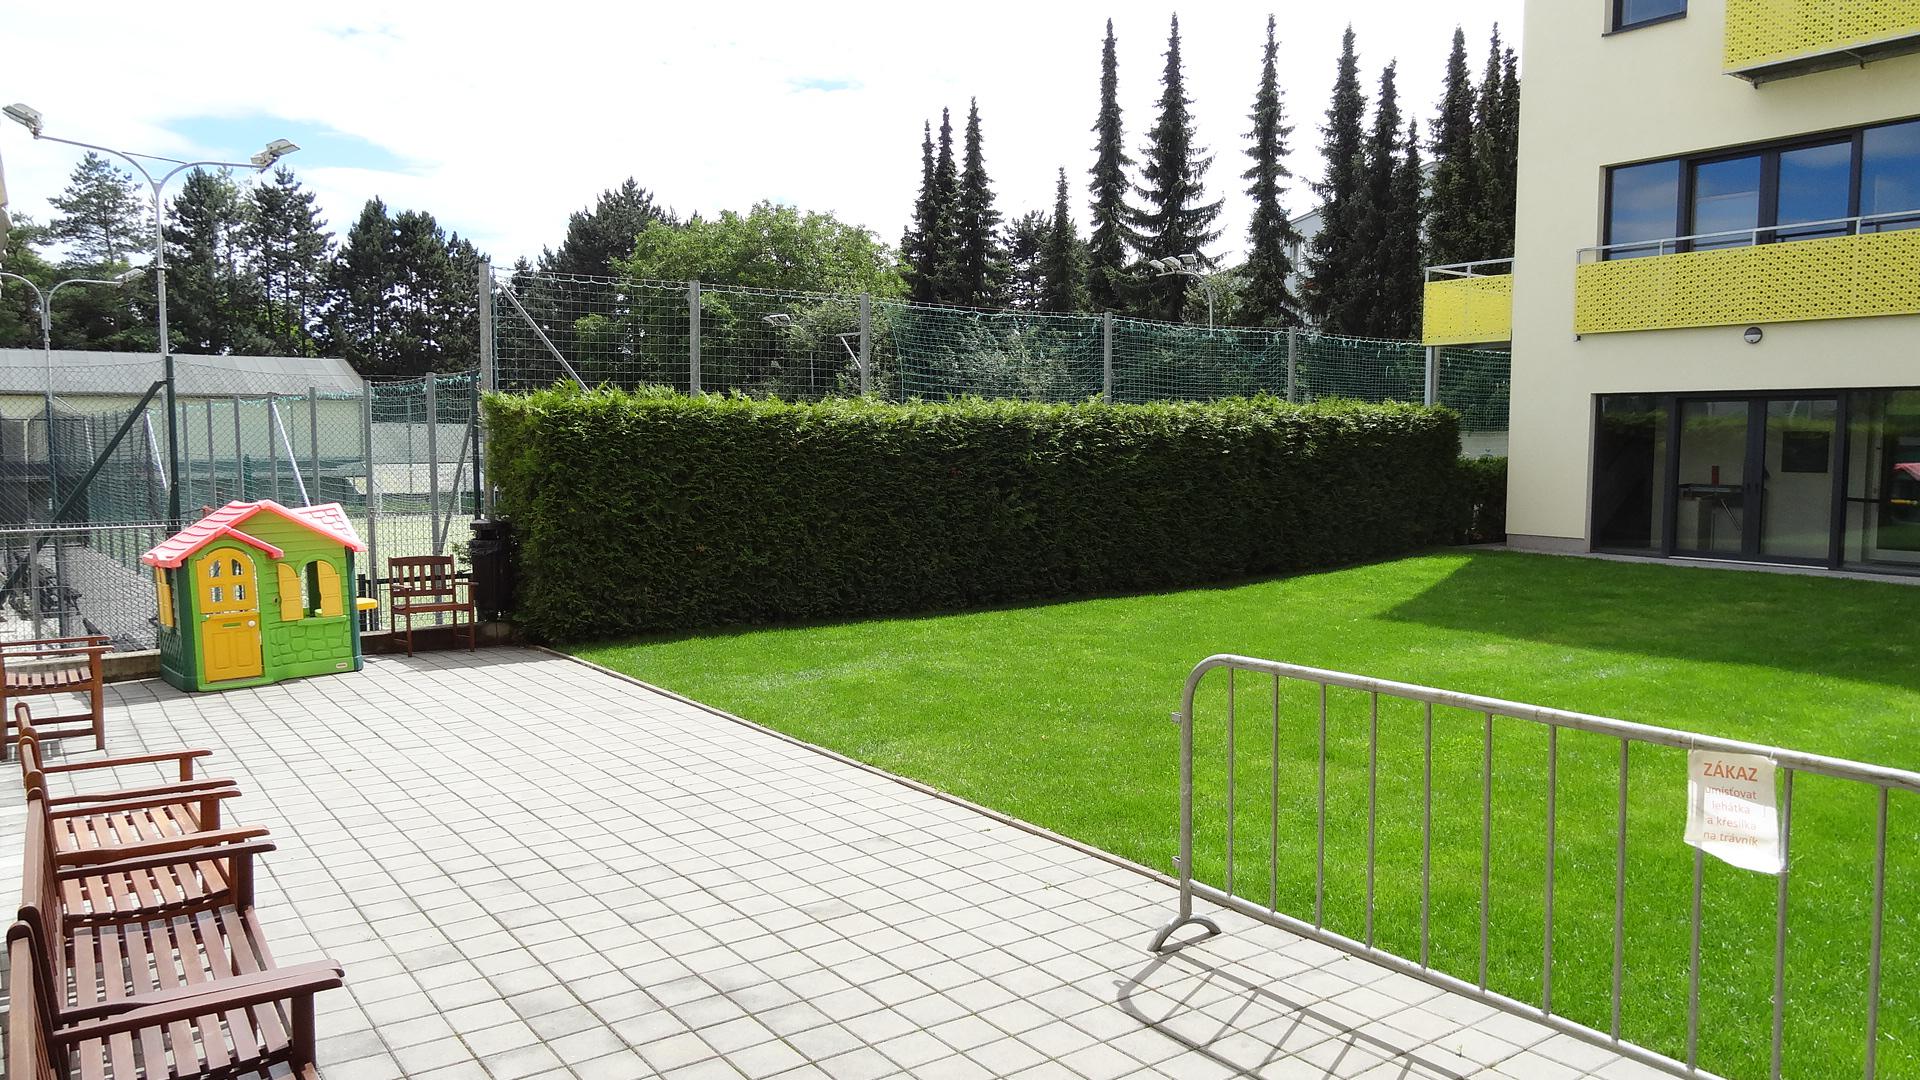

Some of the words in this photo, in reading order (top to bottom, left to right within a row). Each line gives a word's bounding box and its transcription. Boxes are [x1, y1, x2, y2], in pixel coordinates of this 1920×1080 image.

[1703, 760, 1758, 782] ZÁKAZ
[1706, 816, 1714, 825] a
[1703, 831, 1716, 841] na
